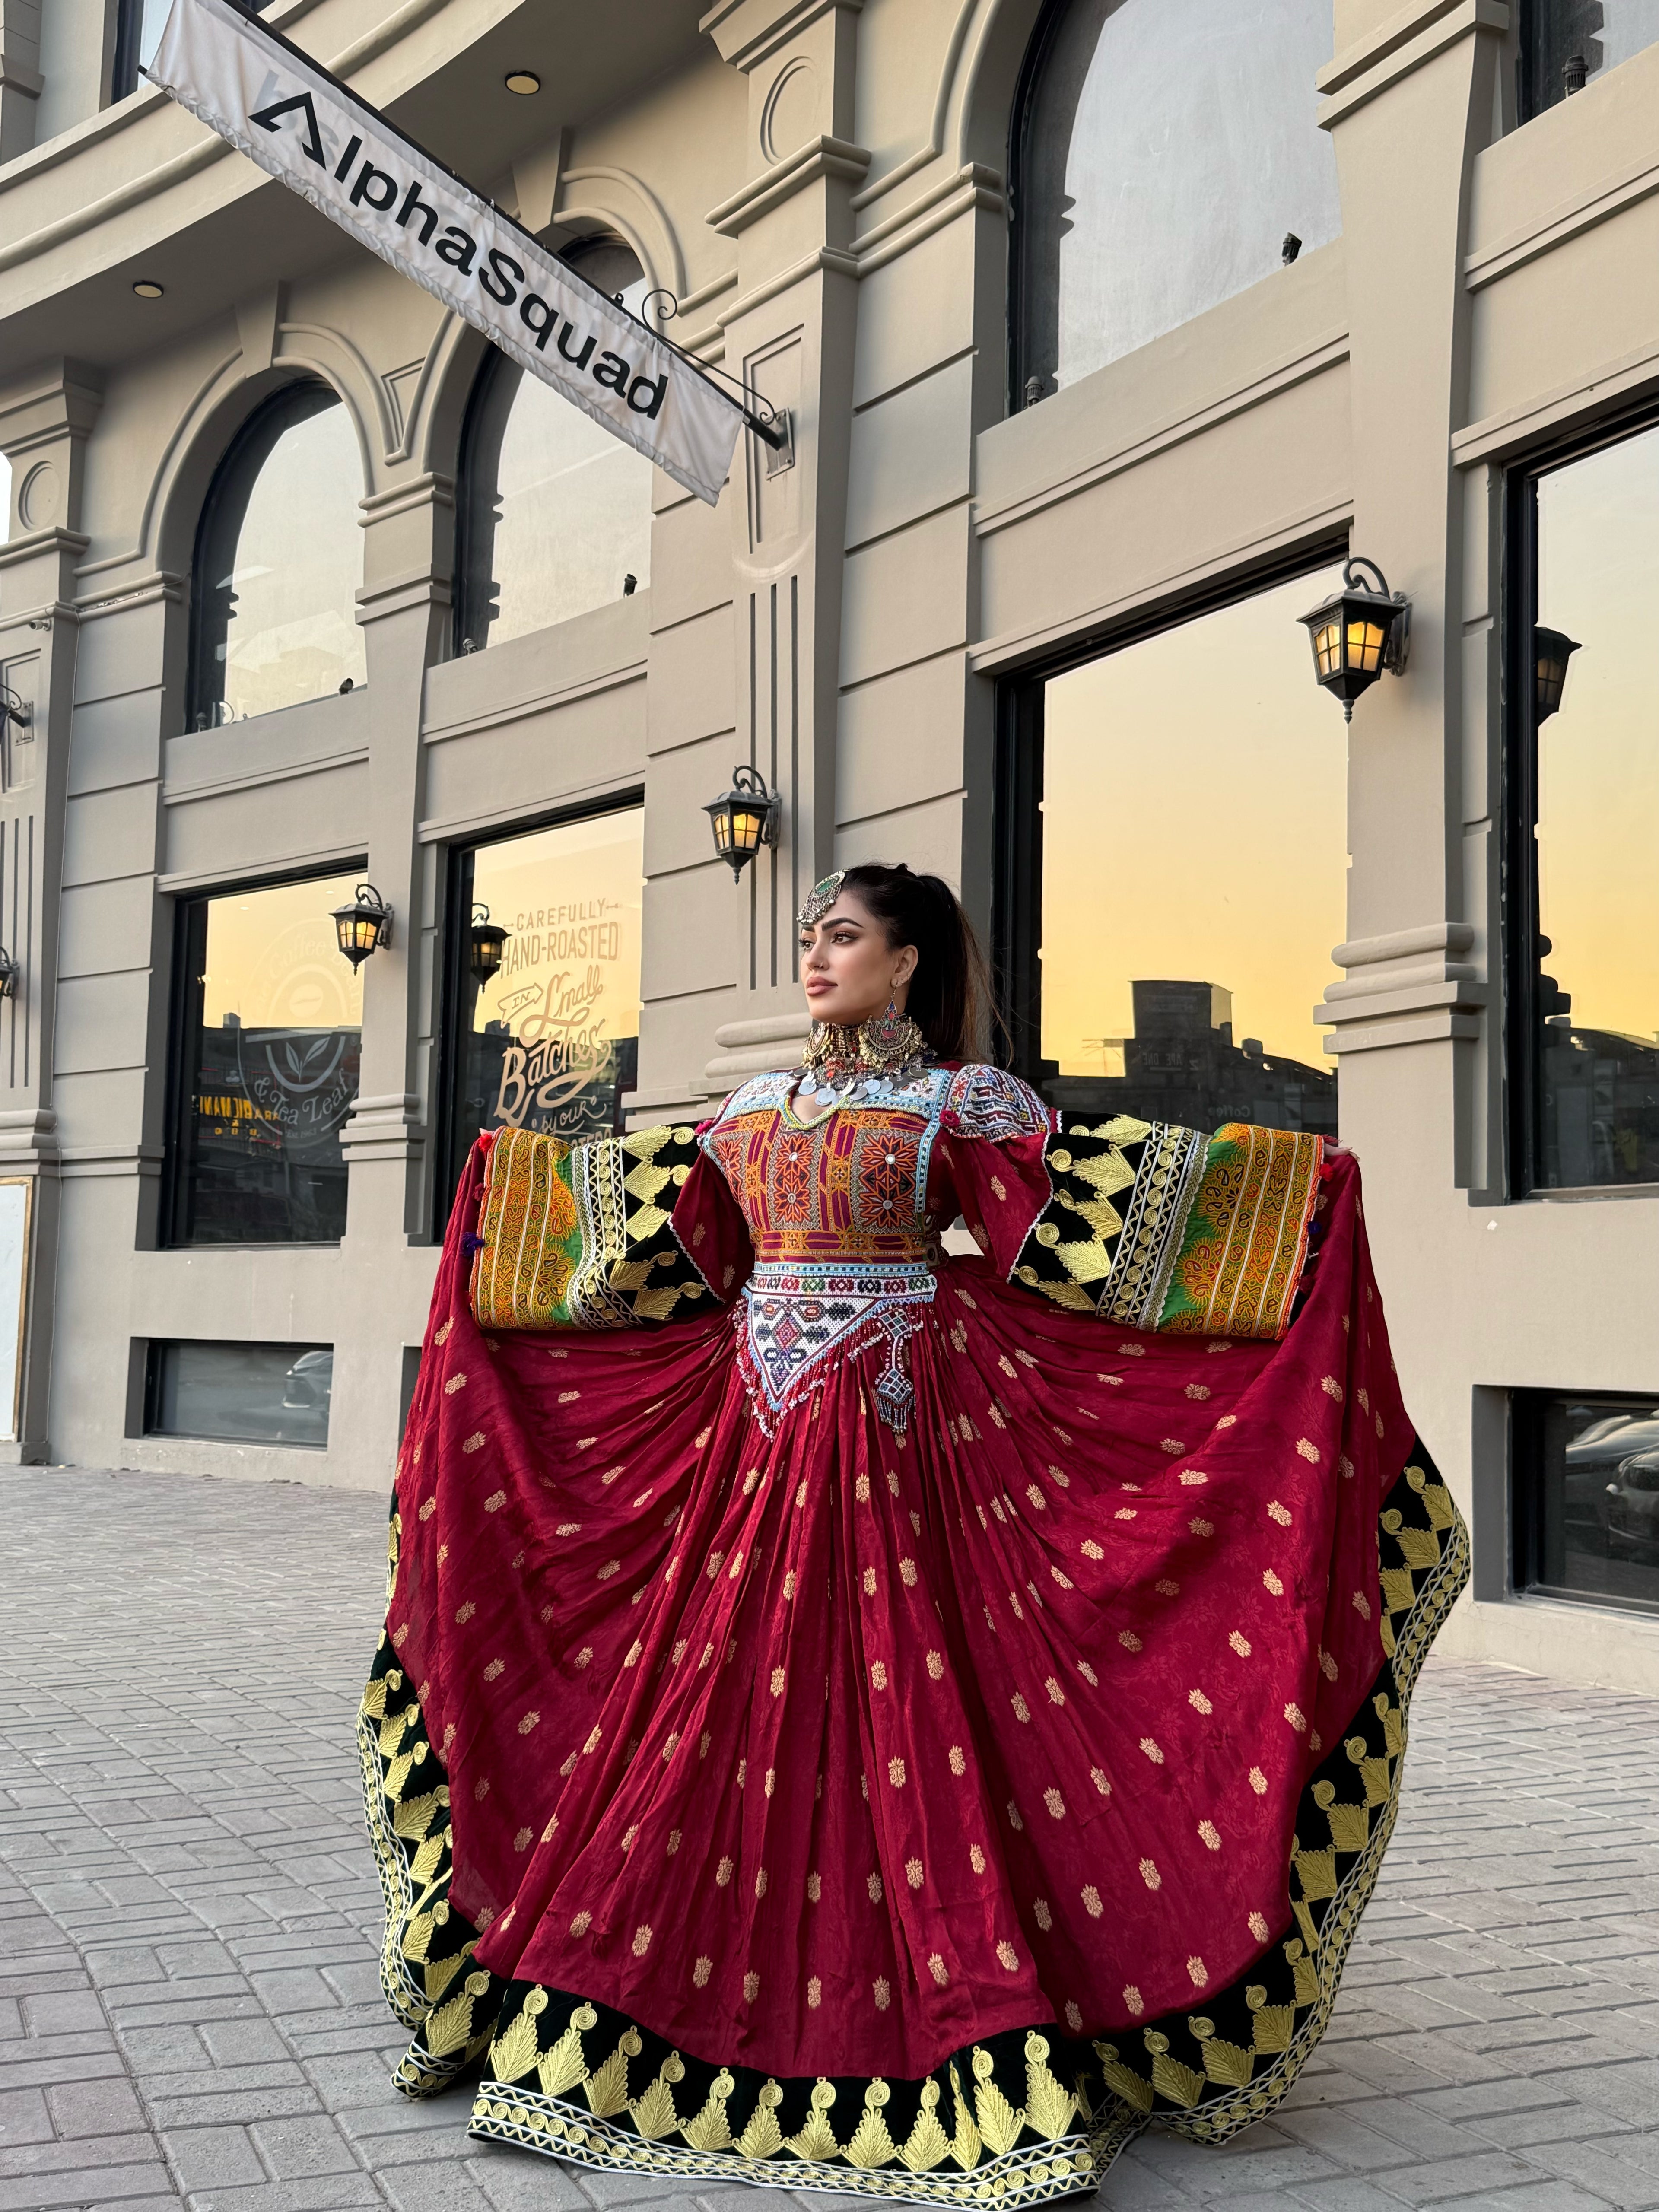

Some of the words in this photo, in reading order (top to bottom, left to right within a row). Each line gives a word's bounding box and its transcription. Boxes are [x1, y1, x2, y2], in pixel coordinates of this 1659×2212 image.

[516, 898, 606, 931] CAREFULLY
[269, 931, 327, 979] Coffee
[500, 921, 618, 979] HAND-ROASTED
[511, 992, 531, 1009] IN
[519, 964, 603, 1048] Small
[270, 1090, 299, 1125] Tea
[302, 1067, 349, 1123] Leaf
[493, 1018, 611, 1128] Batches
